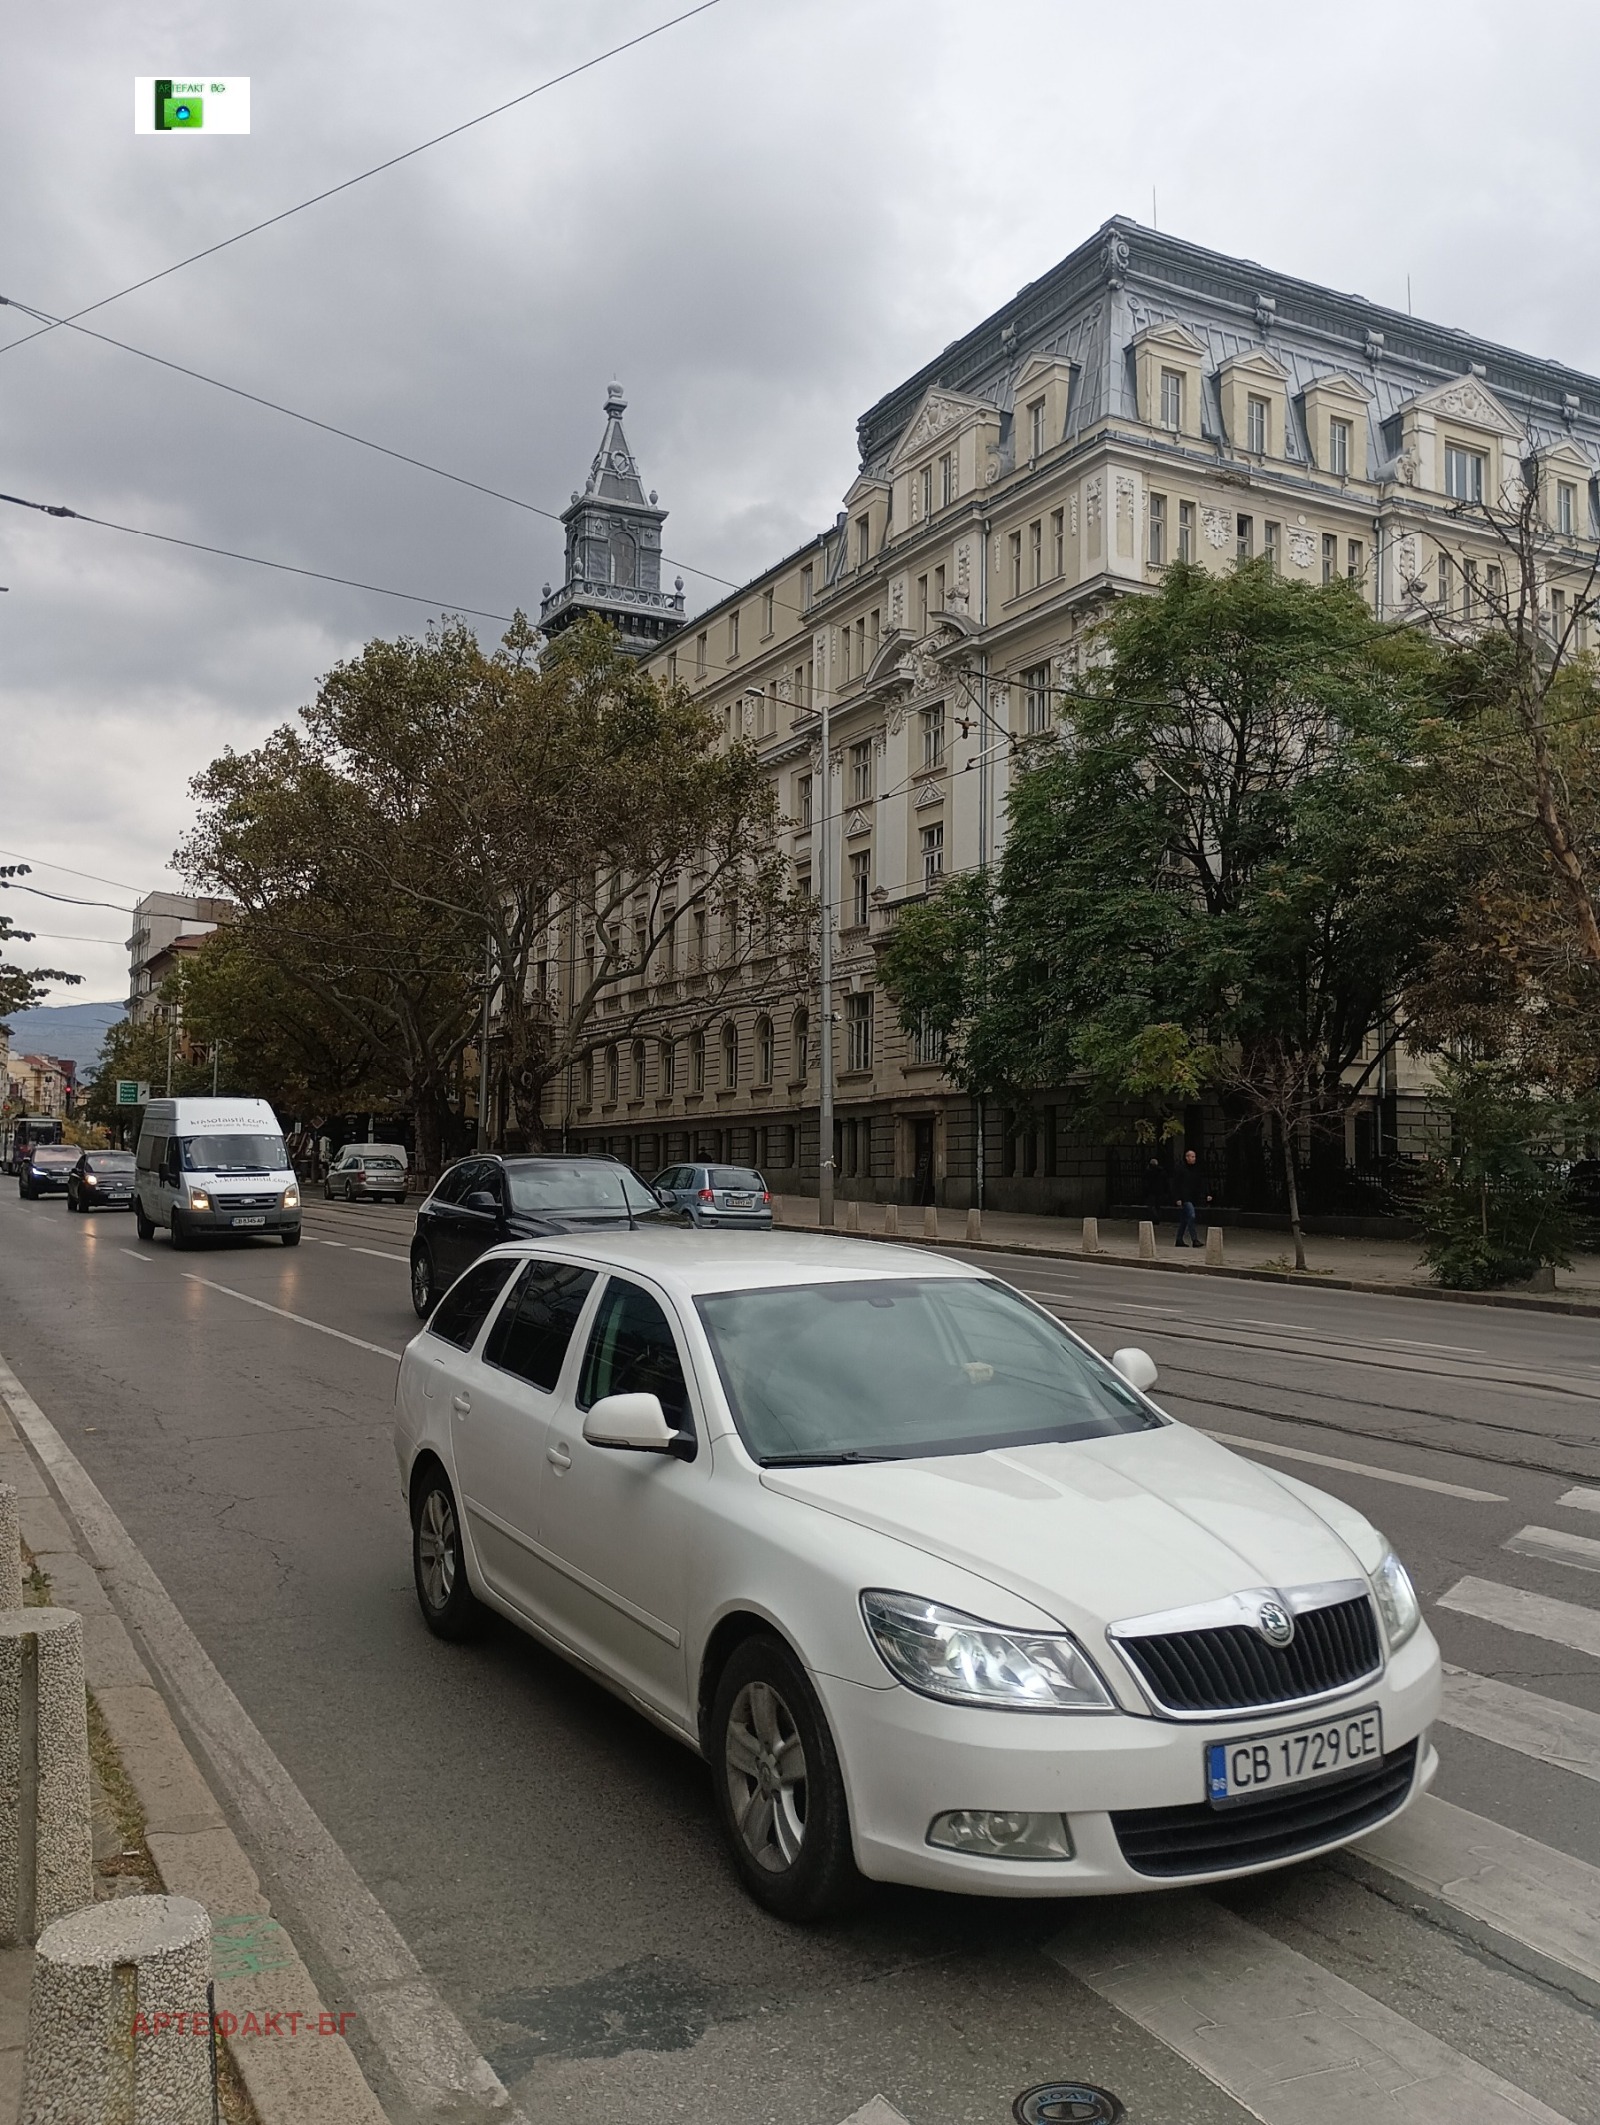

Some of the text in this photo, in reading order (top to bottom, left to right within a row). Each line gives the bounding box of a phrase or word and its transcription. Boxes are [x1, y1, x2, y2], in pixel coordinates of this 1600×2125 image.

[1231, 1717, 1377, 1787] CB 1729 CE
